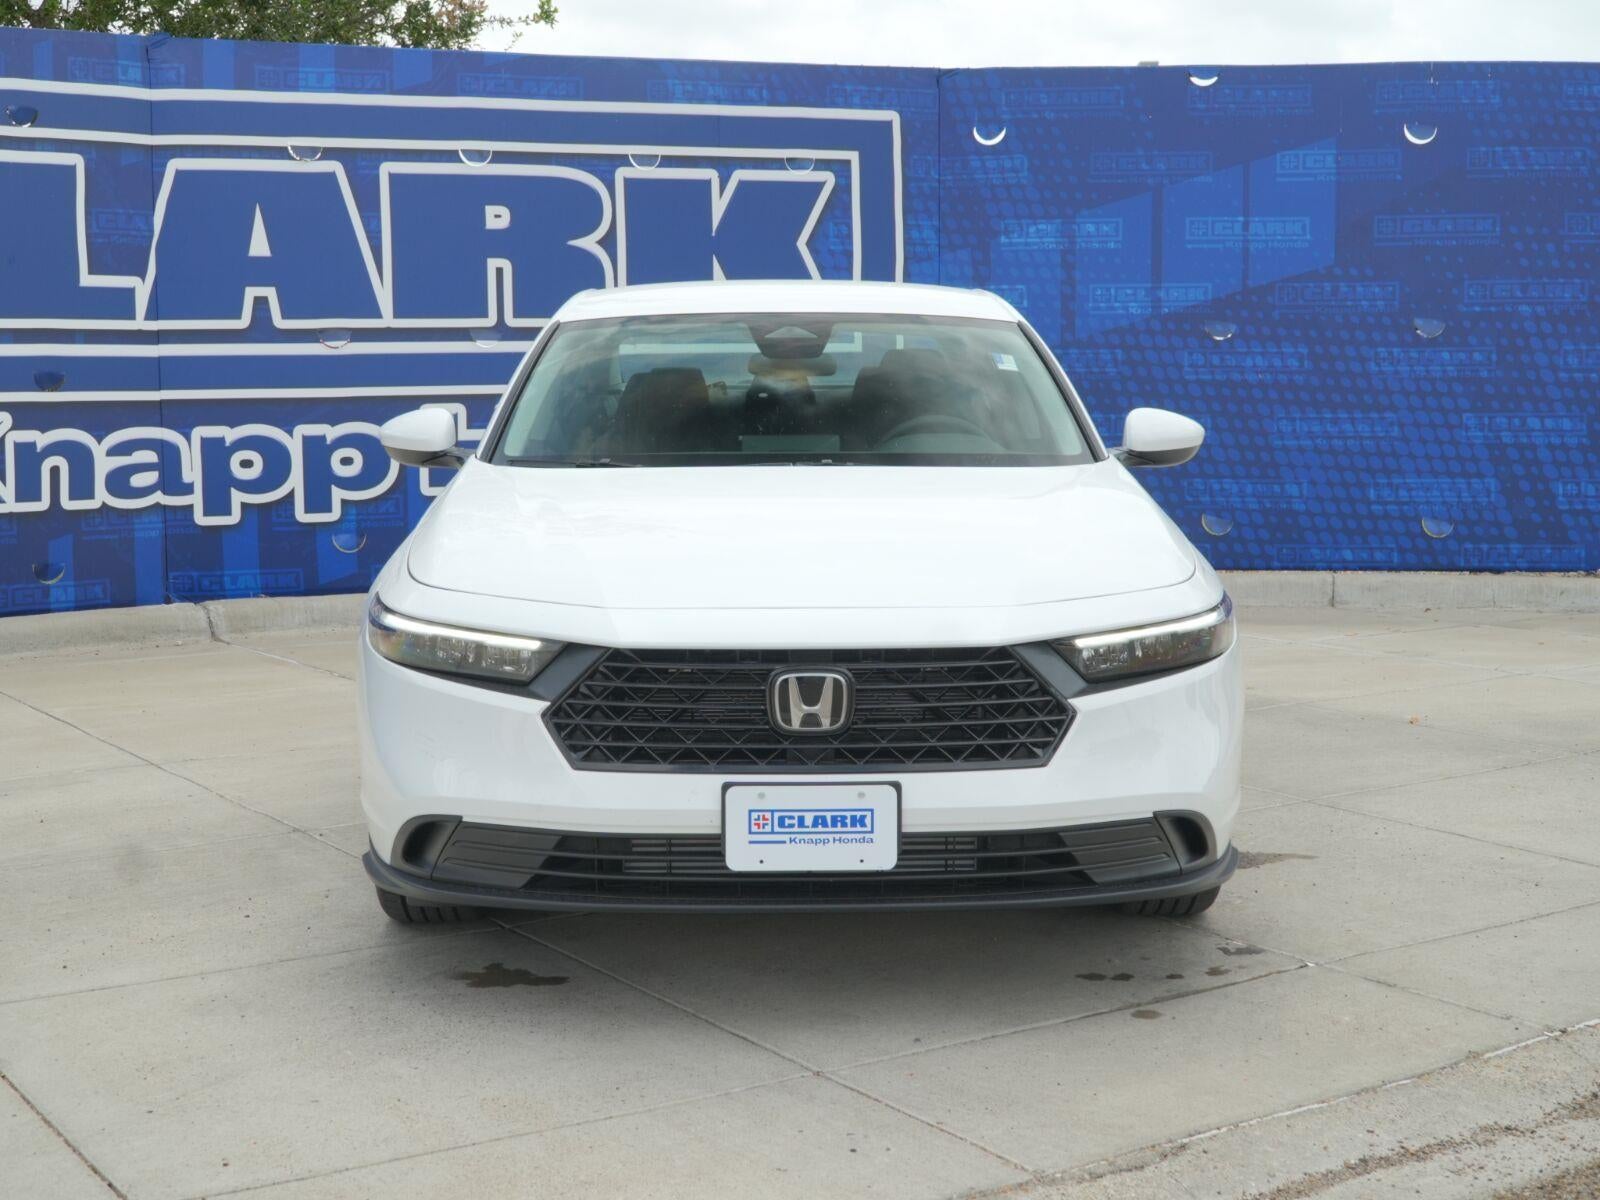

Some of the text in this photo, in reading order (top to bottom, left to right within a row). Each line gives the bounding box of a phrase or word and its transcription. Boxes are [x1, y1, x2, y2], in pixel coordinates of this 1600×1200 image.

[0, 411, 399, 526] napp
[777, 814, 868, 829] CLARK
[789, 836, 874, 846] Knapp Honda
